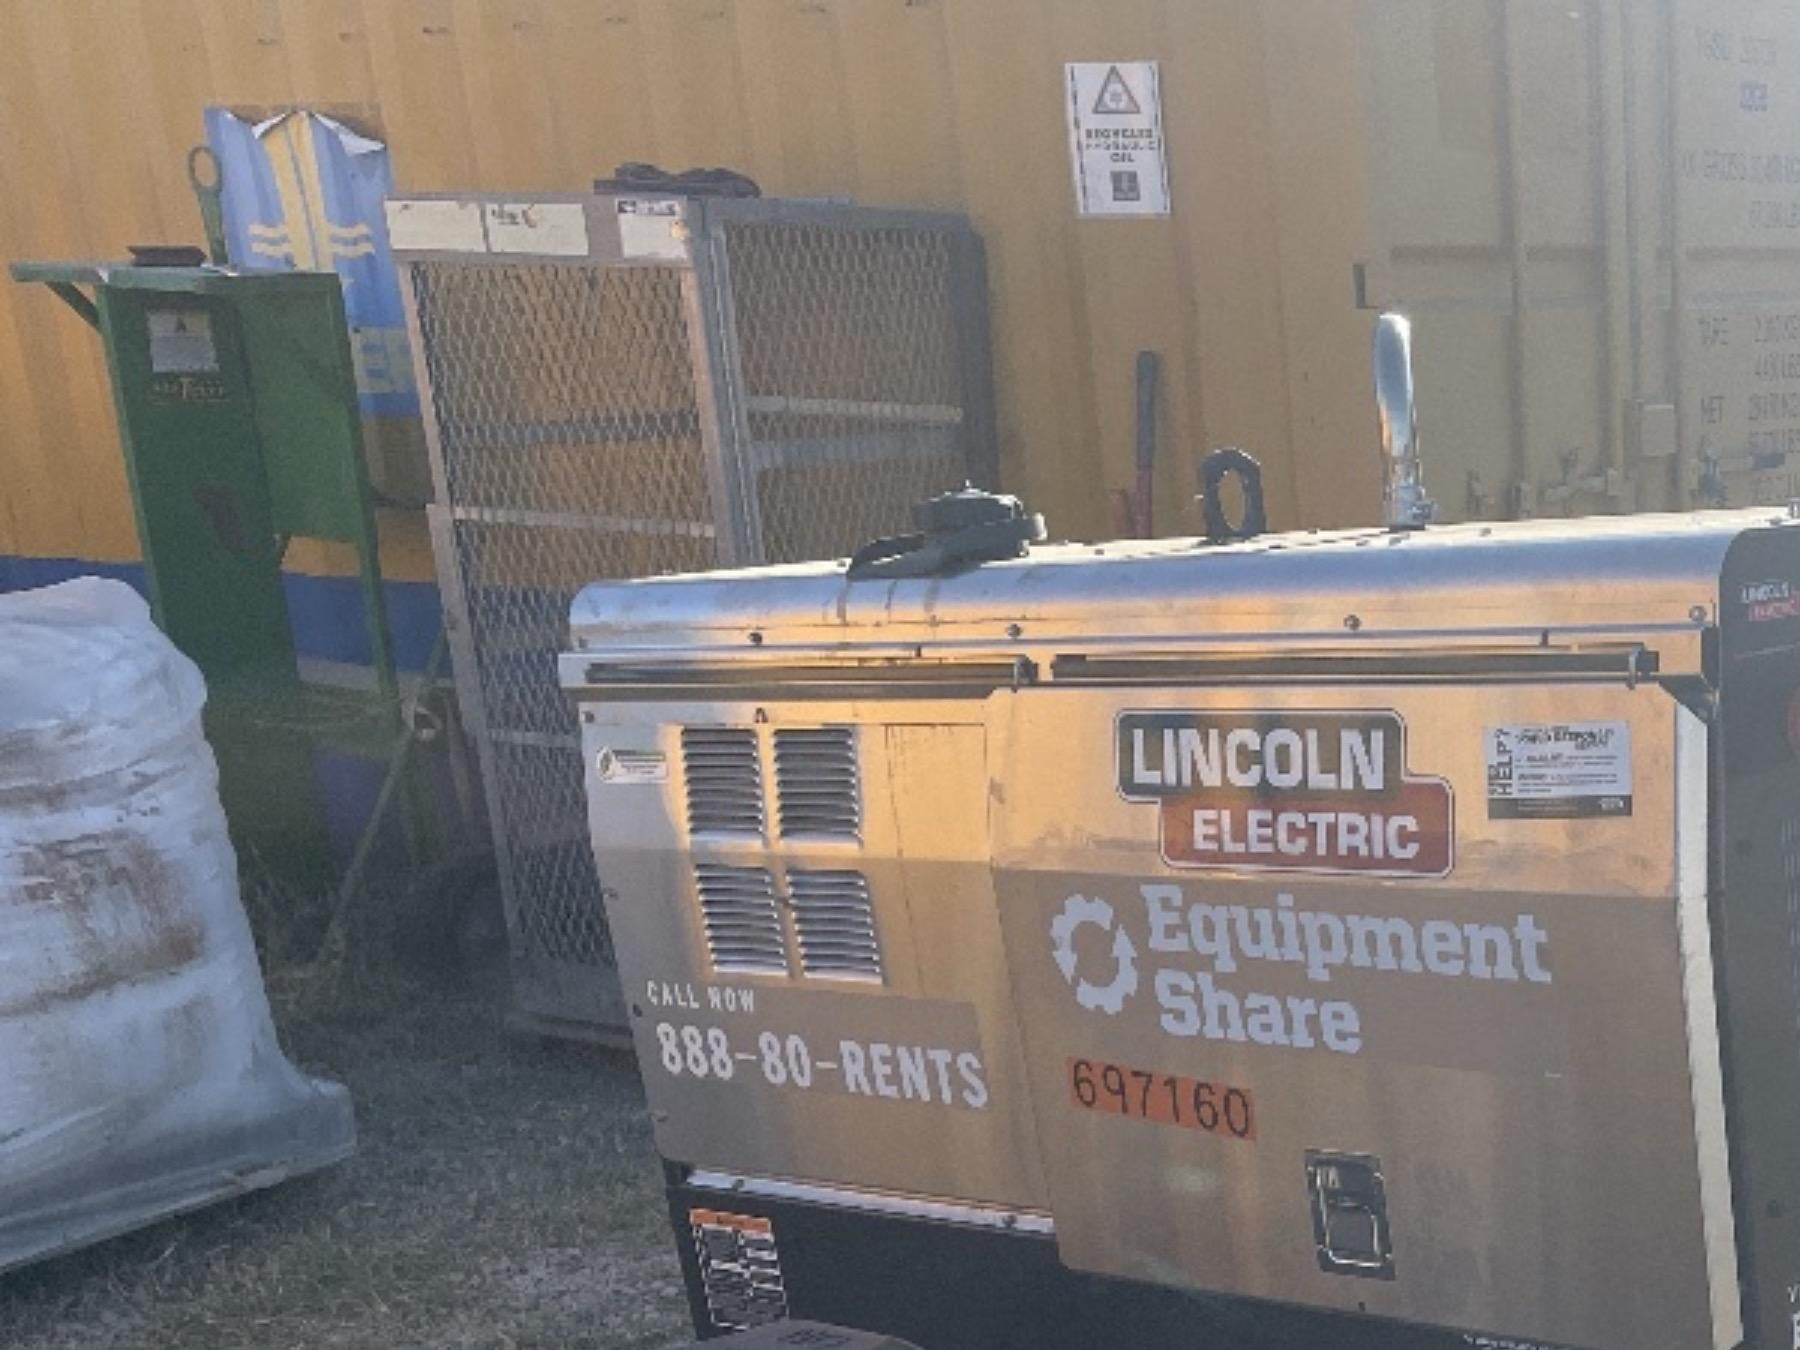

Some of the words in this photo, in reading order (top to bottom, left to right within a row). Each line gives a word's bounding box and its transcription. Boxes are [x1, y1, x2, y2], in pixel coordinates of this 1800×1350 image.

[1132, 727, 1386, 791] LINCOLN
[1193, 808, 1420, 859] ELECTRIC
[1140, 884, 1553, 984] Equipment
[646, 981, 701, 1011] CALL
[708, 988, 756, 1014] NOW
[1154, 970, 1364, 1054] Share
[657, 1023, 988, 1108] 888-80-RENTS
[1073, 1060, 1252, 1138] 697160
